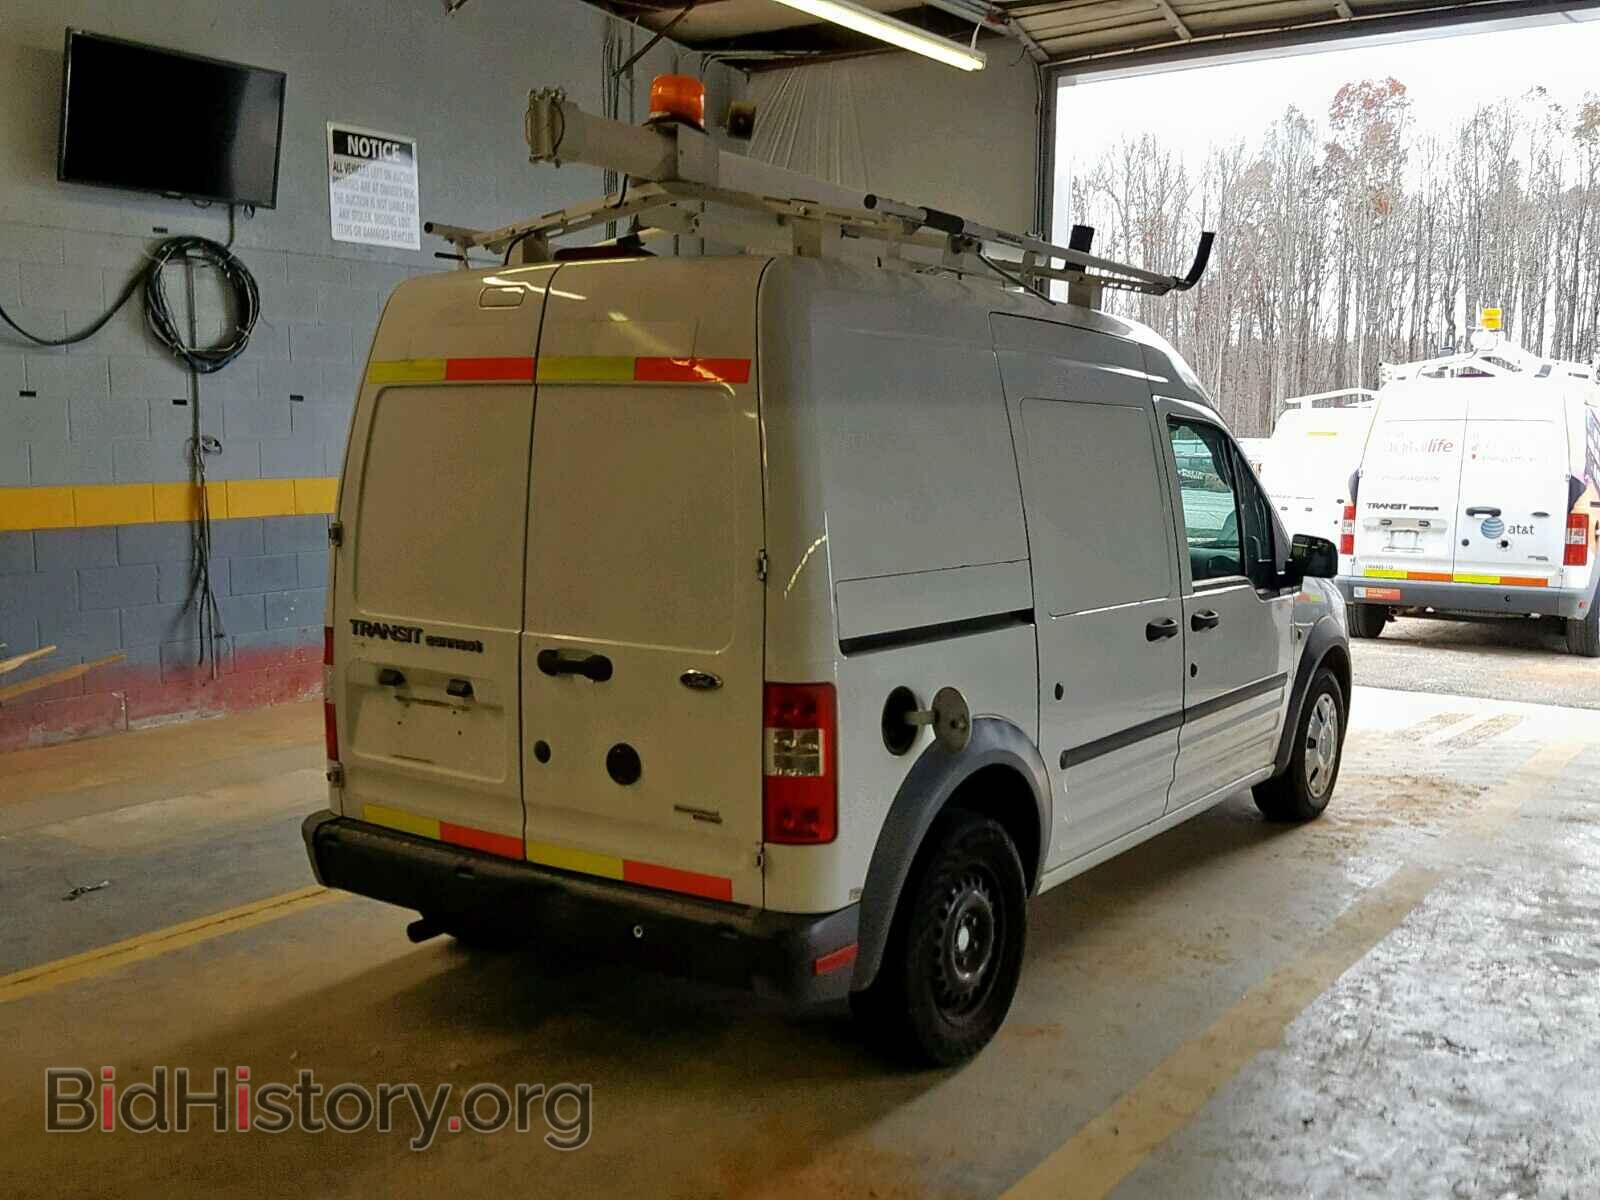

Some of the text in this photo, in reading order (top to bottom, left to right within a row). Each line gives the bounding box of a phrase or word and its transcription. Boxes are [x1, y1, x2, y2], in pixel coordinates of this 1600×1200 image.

[347, 135, 400, 161] NOTICE
[332, 160, 343, 172] ALL
[1508, 523, 1535, 535] at&t
[350, 619, 424, 644] TRANSIT
